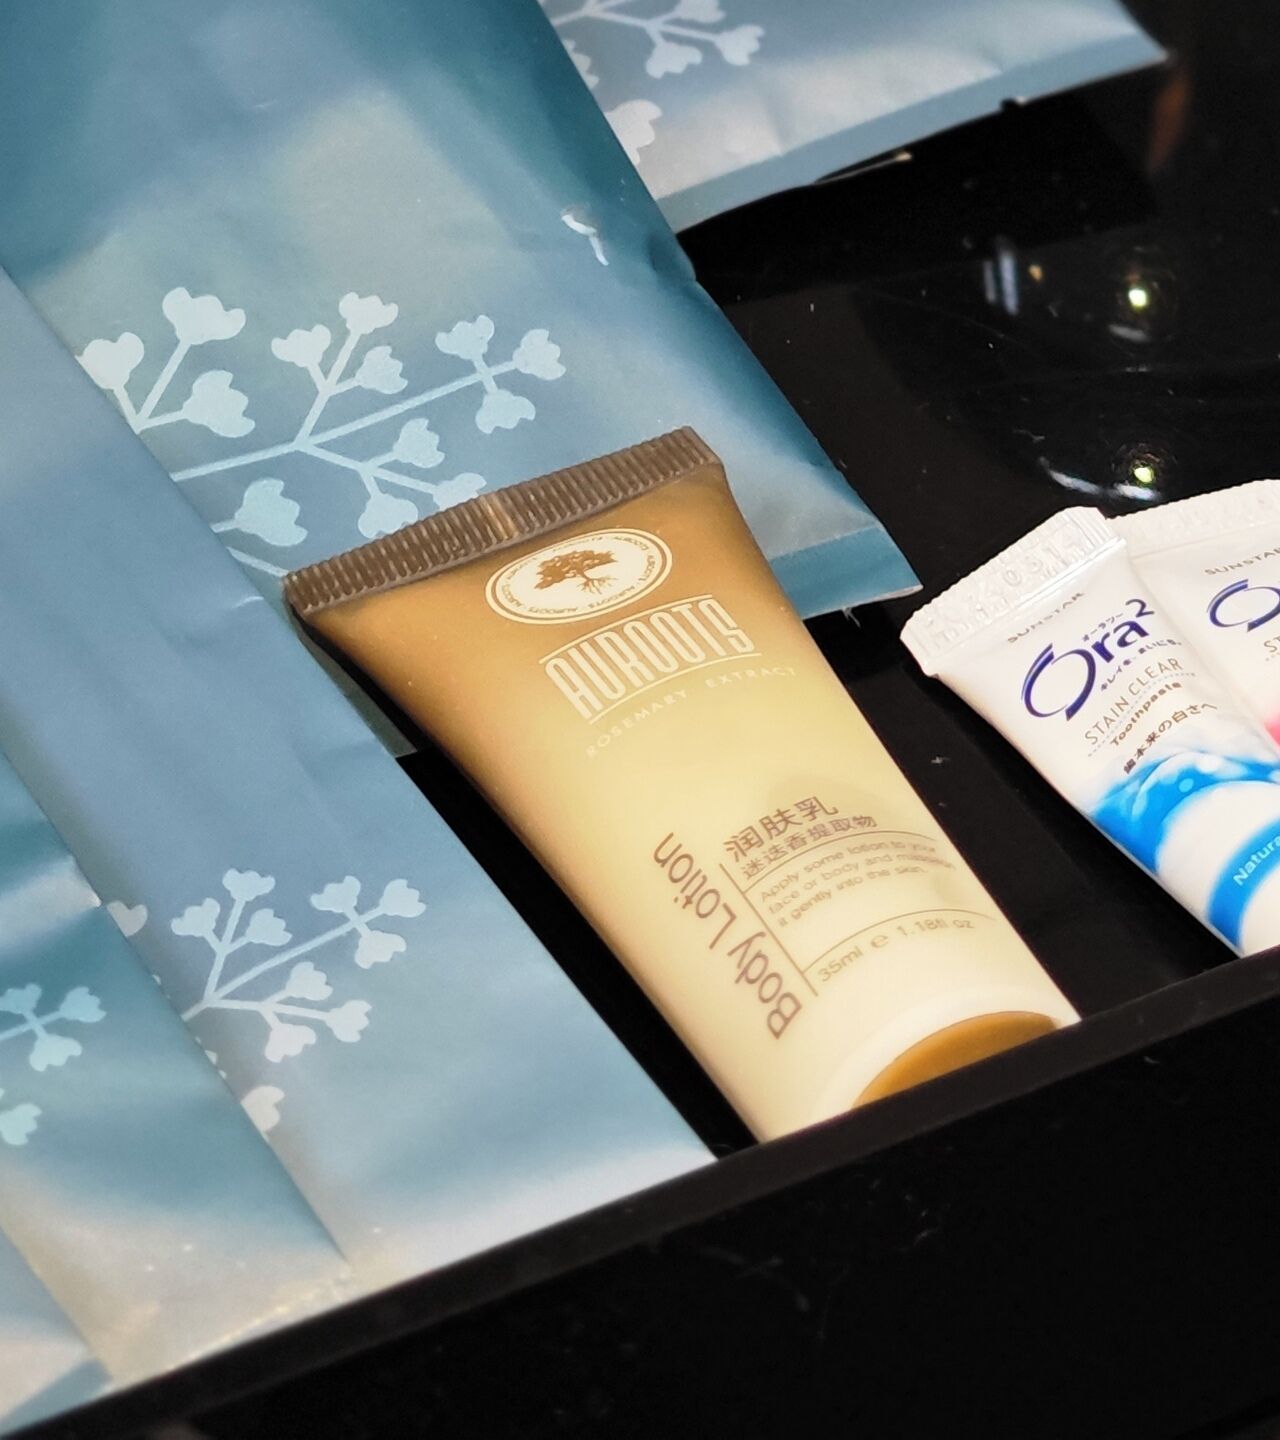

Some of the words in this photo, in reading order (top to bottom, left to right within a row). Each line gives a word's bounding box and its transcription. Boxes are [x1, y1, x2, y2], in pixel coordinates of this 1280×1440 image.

[1007, 591, 1086, 644] SUNSTAR
[545, 598, 756, 720] AUROOTS
[586, 689, 688, 758] ROSEMARY
[705, 666, 797, 689] EXTRACT
[1084, 695, 1130, 746] STAIN
[1128, 657, 1184, 697] CLEAR
[1109, 680, 1183, 748] Toothpaste
[724, 796, 839, 862] 润肤乳
[742, 814, 878, 880] 迷迭香提取物
[653, 832, 737, 950] Lotion
[761, 872, 800, 902] Apply
[803, 851, 844, 872] some
[847, 840, 889, 856] lotion
[891, 841, 906, 850] to
[768, 890, 800, 913] face
[803, 879, 819, 891] or
[821, 861, 860, 881] body
[864, 854, 893, 866] and
[791, 889, 832, 921] gently
[836, 875, 864, 892] into
[867, 867, 891, 880] the
[727, 931, 803, 1040] Body
[818, 945, 864, 983] 35ml
